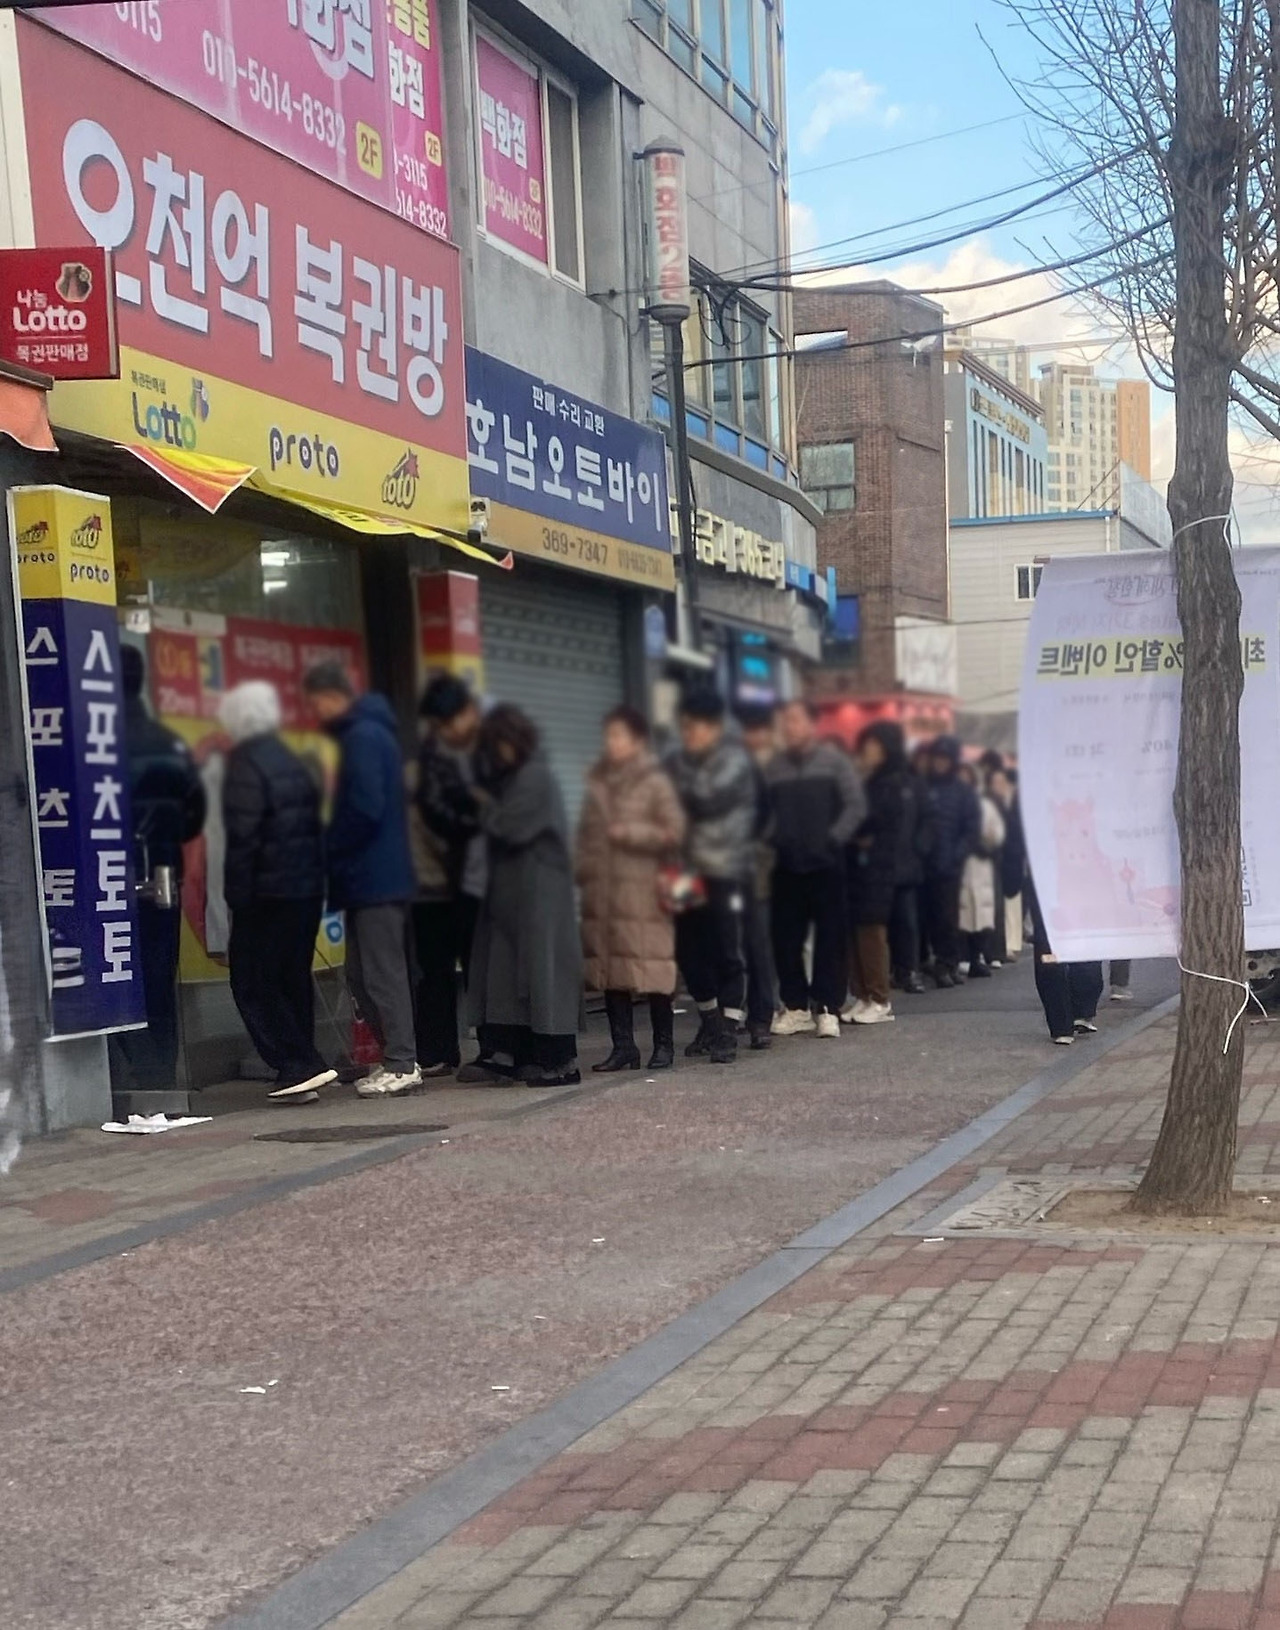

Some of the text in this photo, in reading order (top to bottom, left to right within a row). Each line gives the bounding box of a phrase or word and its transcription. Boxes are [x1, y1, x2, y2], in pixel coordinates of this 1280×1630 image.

[360, 133, 379, 168] 2F
[12, 304, 87, 331] Lotto
[294, 224, 448, 416] 복권방
[131, 391, 197, 450] Lotto
[559, 399, 581, 428] 수리
[269, 427, 339, 478] proto
[466, 398, 662, 532] 호남오토바이
[70, 562, 110, 584] proto
[80, 629, 133, 983] 스포츠토토
